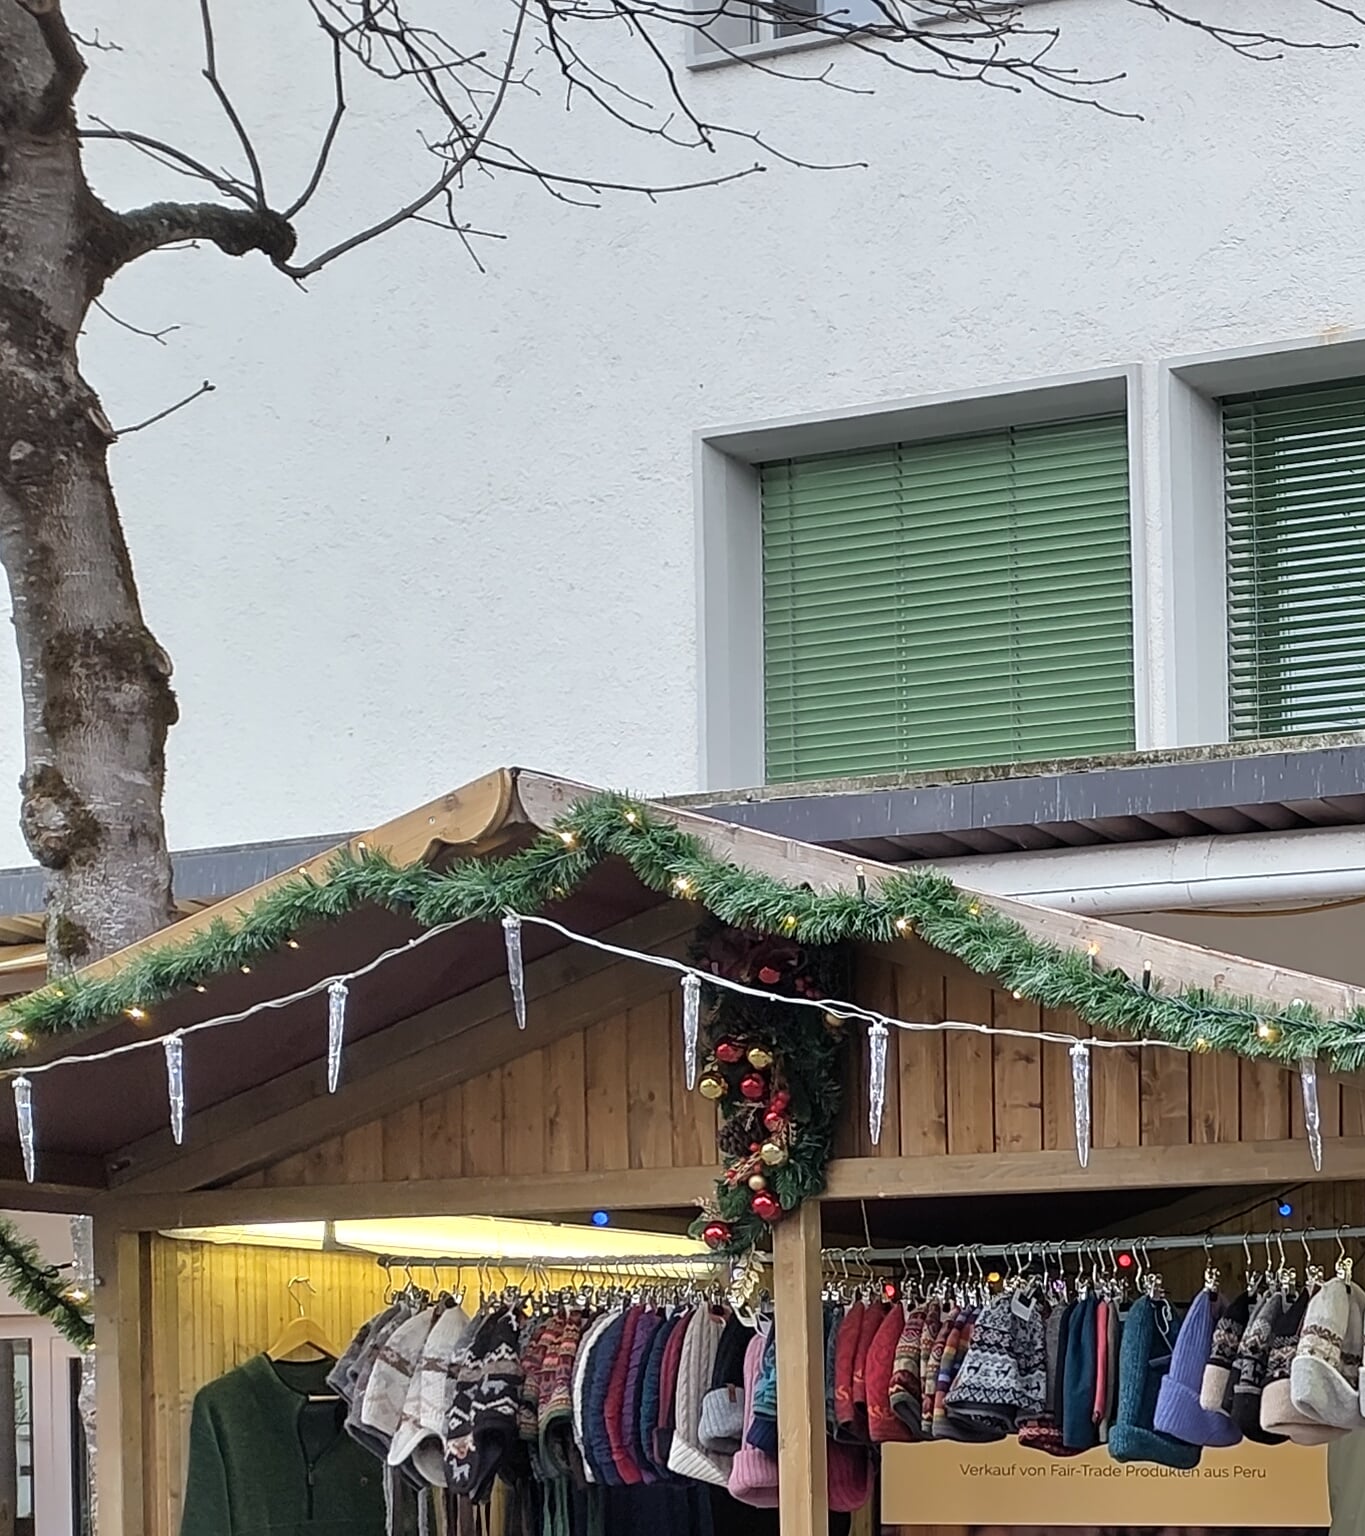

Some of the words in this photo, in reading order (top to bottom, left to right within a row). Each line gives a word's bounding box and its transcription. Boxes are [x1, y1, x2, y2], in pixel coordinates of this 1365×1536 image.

[960, 1463, 1017, 1477] Verkauf
[1019, 1466, 1046, 1477] von
[1050, 1465, 1122, 1478] Fair-Trade
[1204, 1468, 1230, 1478] aus
[1233, 1466, 1267, 1479] Peru
